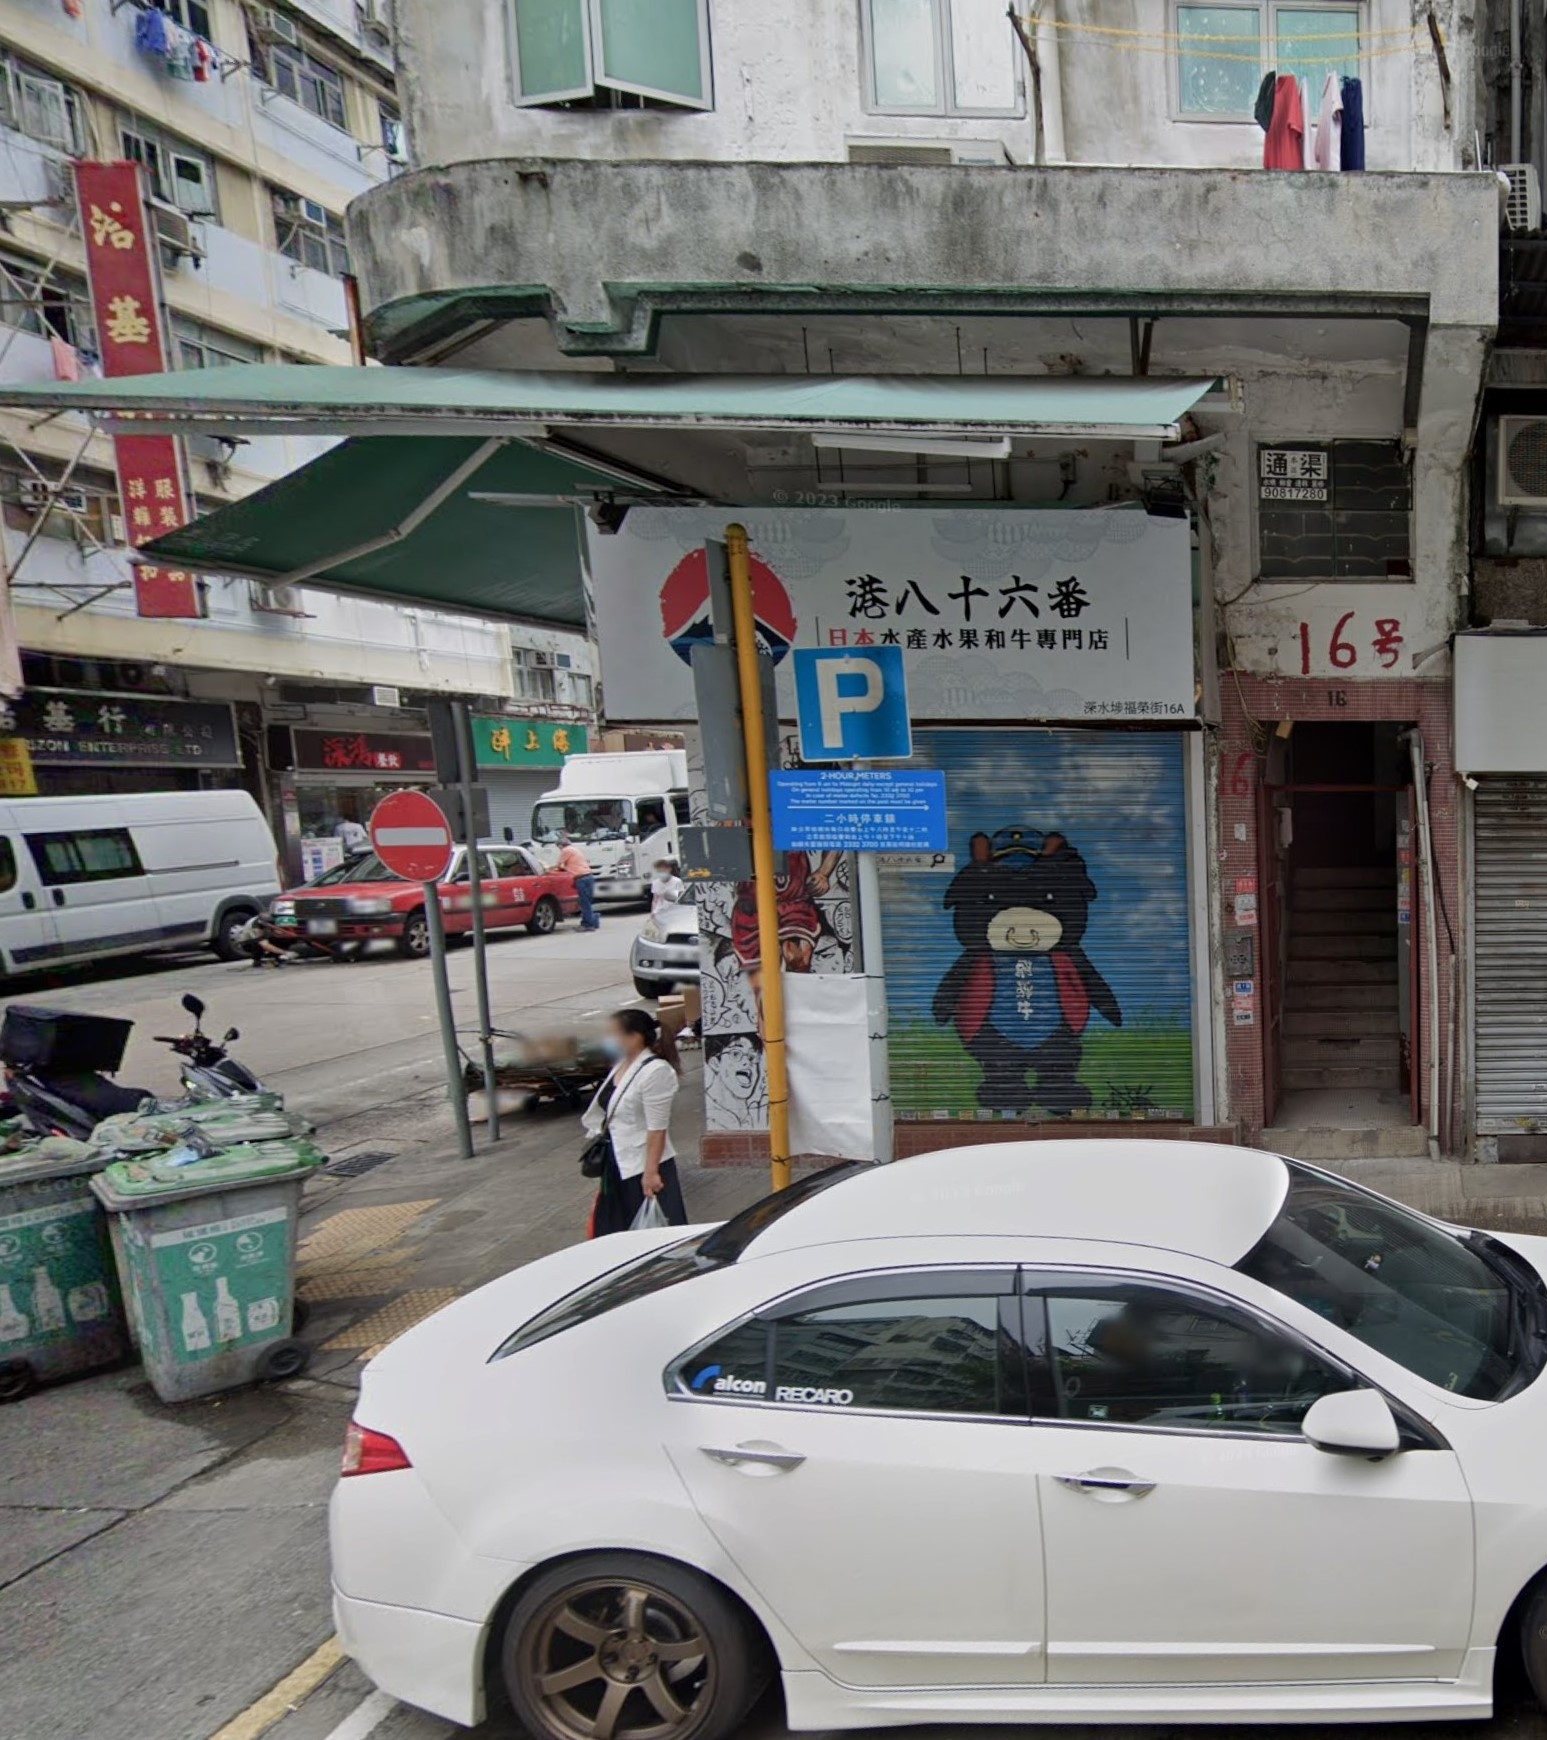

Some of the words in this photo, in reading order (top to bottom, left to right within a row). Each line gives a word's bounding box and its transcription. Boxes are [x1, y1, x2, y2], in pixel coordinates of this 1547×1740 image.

[1266, 452, 1323, 477] 通渠
[1264, 487, 1324, 499] 90817280
[844, 574, 1092, 621] 港八十六番
[828, 627, 1109, 651] 日本水產水果和牛專門店
[816, 657, 885, 749] P
[1328, 690, 1347, 707] 16
[79, 741, 169, 754] ENTERPRISE
[820, 772, 856, 780] 2-HOUR
[857, 772, 892, 780] METERS
[713, 1375, 766, 1394] alcon
[775, 1387, 854, 1405] RECARO
